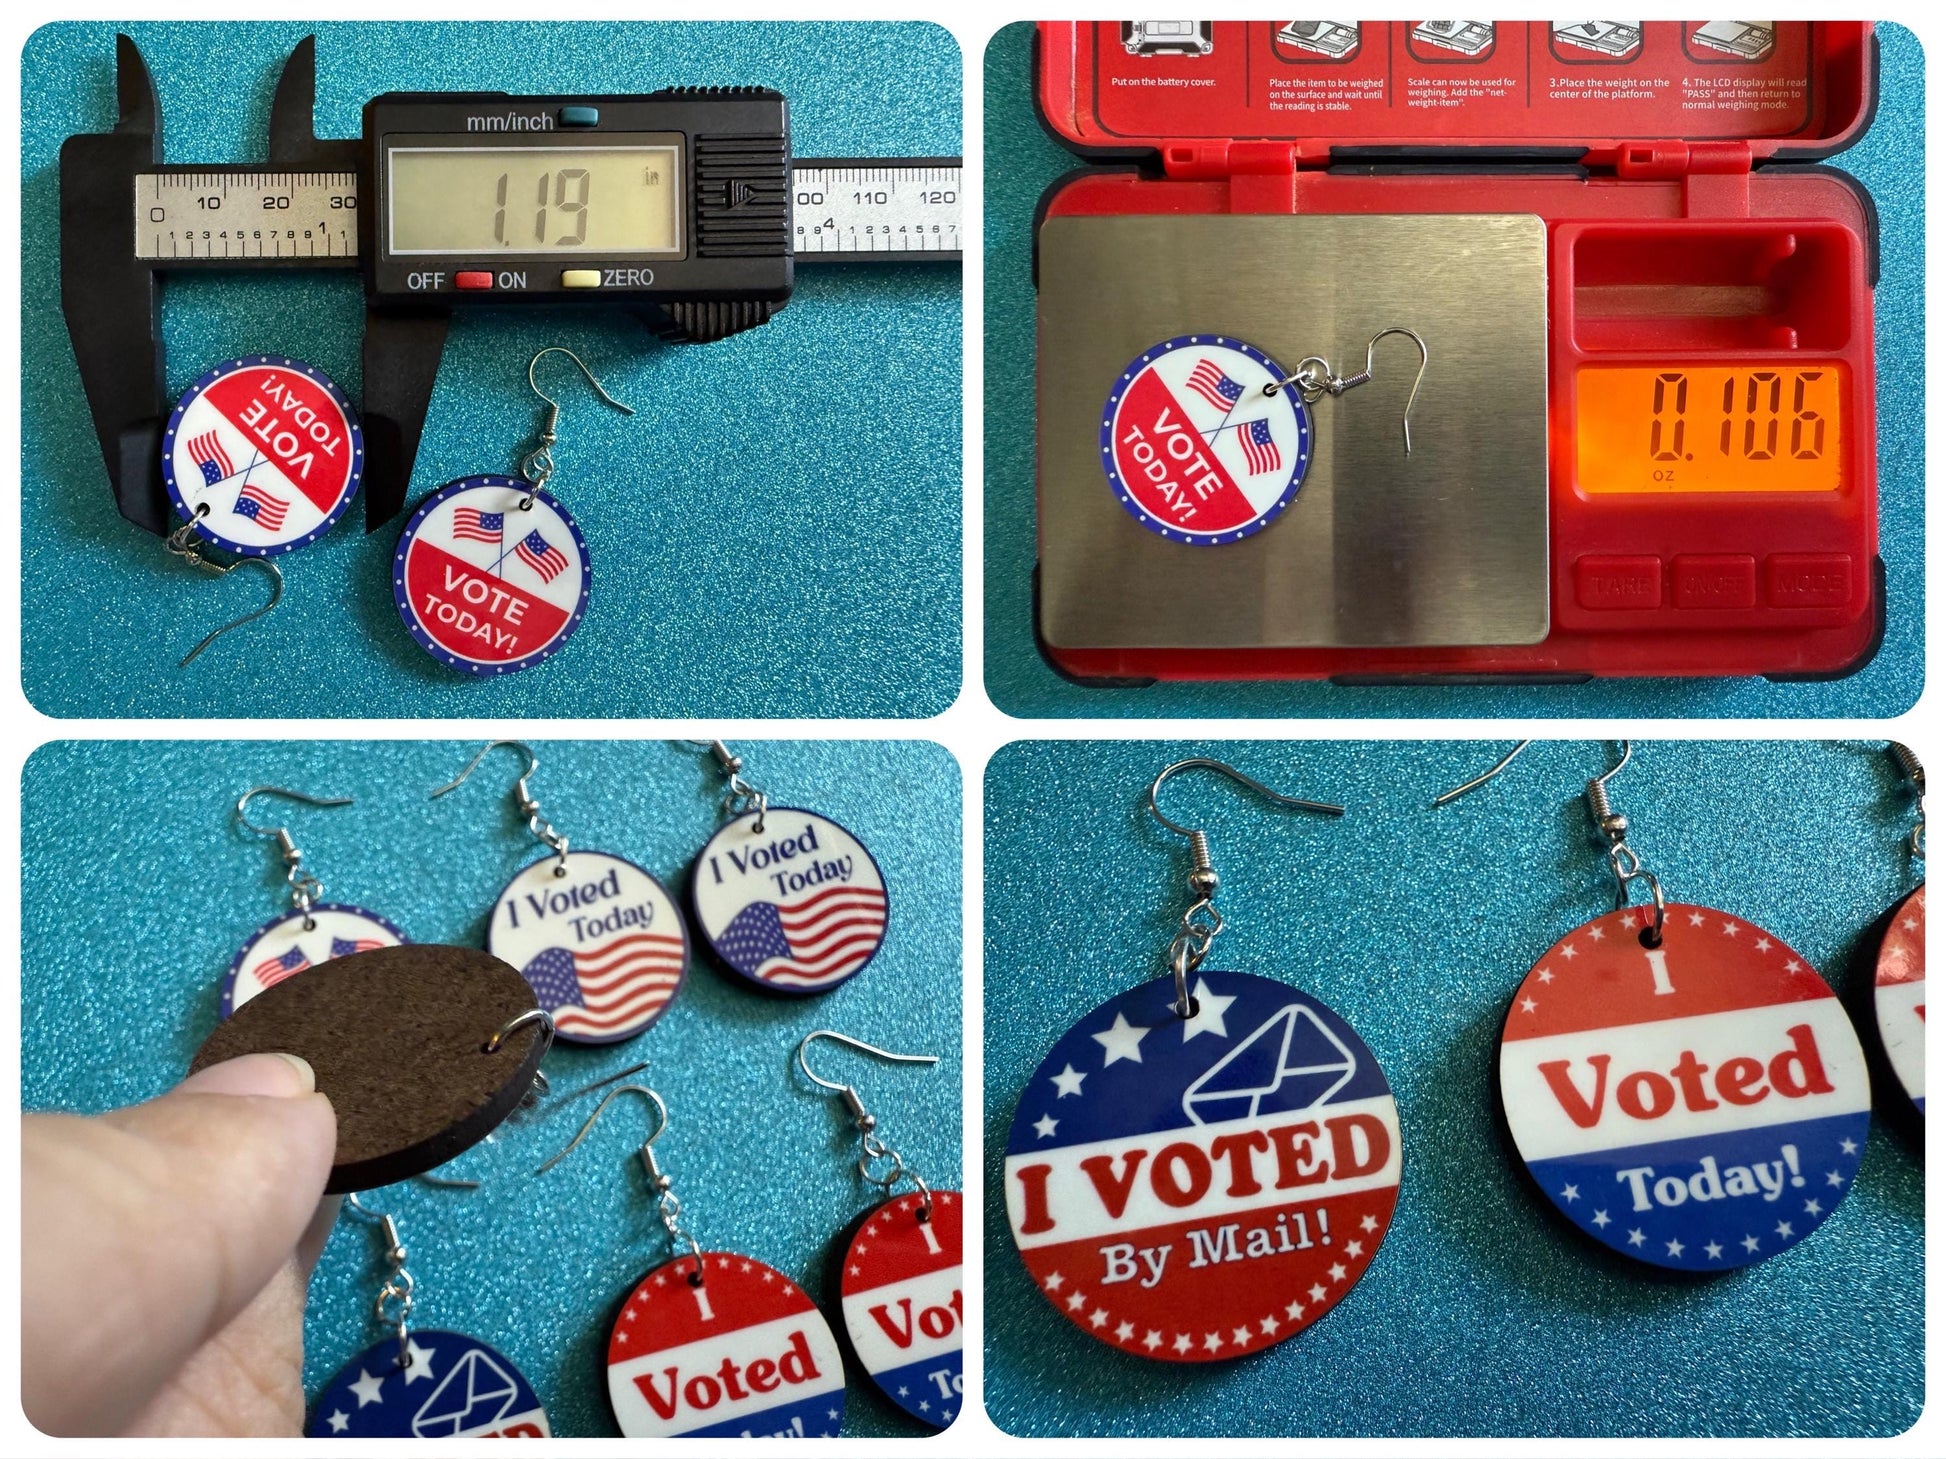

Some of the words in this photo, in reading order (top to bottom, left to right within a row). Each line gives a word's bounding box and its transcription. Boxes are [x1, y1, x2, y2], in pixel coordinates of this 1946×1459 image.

[1112, 77, 1127, 86] Put
[1141, 77, 1156, 86] the
[1158, 77, 1188, 88] battery
[1269, 79, 1291, 87] Place
[1293, 79, 1306, 87] the
[1307, 79, 1326, 87] item
[1327, 79, 1336, 87] to
[1338, 79, 1348, 87] be
[1350, 79, 1384, 89] weighed
[1269, 91, 1280, 99] on
[1282, 90, 1295, 99] the
[1297, 90, 1325, 99] surface
[1327, 90, 1342, 99] and
[1344, 90, 1362, 99] wait
[1363, 90, 1382, 99] until
[1407, 78, 1430, 86] Scale
[1469, 78, 1480, 86] be
[1482, 78, 1502, 86] used
[1503, 78, 1516, 86] for
[1407, 88, 1449, 98] weighing.
[1451, 88, 1467, 96] Add
[1469, 88, 1484, 96] the
[1549, 90, 1579, 98] center
[1582, 89, 1592, 98] of
[1594, 89, 1609, 98] the
[1611, 89, 1656, 100] platform.
[1587, 78, 1602, 87] the
[1605, 78, 1637, 89] weight
[1654, 78, 1670, 87] the
[1682, 78, 1691, 86] 4.
[1694, 78, 1711, 86] The
[1713, 78, 1731, 86] LCD
[1733, 78, 1767, 88] display
[1767, 78, 1784, 86] will
[1786, 78, 1807, 86] read
[1682, 89, 1715, 98] "PASS"
[1718, 90, 1735, 98] and
[1738, 90, 1758, 98] then
[1791, 90, 1801, 98] to
[467, 112, 553, 131] mm/inch
[1269, 102, 1283, 110] the
[1285, 102, 1315, 112] reading
[1317, 102, 1324, 110] is
[1325, 102, 1352, 110] stable.
[1682, 100, 1715, 109] normal
[1717, 100, 1759, 111] weighing
[1761, 100, 1789, 109] mode.
[150, 207, 165, 222] 0
[197, 196, 221, 210] 10
[262, 196, 289, 210] 20
[330, 196, 357, 209] 30
[494, 168, 590, 246] 1.19
[797, 192, 824, 205] 00
[853, 191, 888, 205] 110
[919, 191, 956, 204] 120
[169, 231, 175, 239] 1
[186, 231, 193, 239] 2
[202, 231, 211, 239] 3
[219, 231, 227, 239] 4
[236, 231, 244, 239] 5
[253, 231, 261, 239] 6
[270, 231, 278, 239] 7
[287, 230, 295, 239] 8
[304, 230, 312, 239] 9
[318, 222, 326, 235] 1
[340, 230, 346, 239] 1
[797, 226, 804, 234] 8
[814, 226, 821, 234] 9
[823, 217, 834, 230] 4
[849, 226, 855, 234] 1
[866, 226, 873, 234] 2
[882, 226, 890, 234] 3
[899, 226, 907, 234] 4
[916, 225, 924, 233] 5
[932, 225, 940, 233] 6
[949, 225, 956, 233] 7
[407, 272, 445, 290] OFF
[499, 271, 527, 290] ON
[603, 268, 654, 287] ZERO
[260, 374, 341, 457] TODAY!
[1650, 371, 1825, 461] 0.106
[239, 398, 315, 480] VOTE
[1152, 406, 1224, 501] VOTE
[1122, 425, 1197, 523] TODAY!
[444, 564, 529, 626] VOTE
[424, 593, 518, 654] TODAY!
[709, 857, 724, 884] I
[726, 823, 820, 875] Voted
[769, 854, 853, 899] Today
[506, 900, 519, 929] I
[525, 869, 621, 920] Voted
[568, 900, 654, 945] Today
[1644, 949, 1676, 996] I
[1537, 1023, 1836, 1129] Voted
[1016, 1163, 1056, 1236] I
[1080, 1113, 1391, 1220] VOTED
[1616, 1144, 1806, 1213] Today!
[919, 1222, 942, 1255] I
[1099, 1242, 1173, 1289] By
[1186, 1208, 1332, 1269] Mail!
[692, 1286, 716, 1321] I
[633, 1330, 822, 1420] Voted
